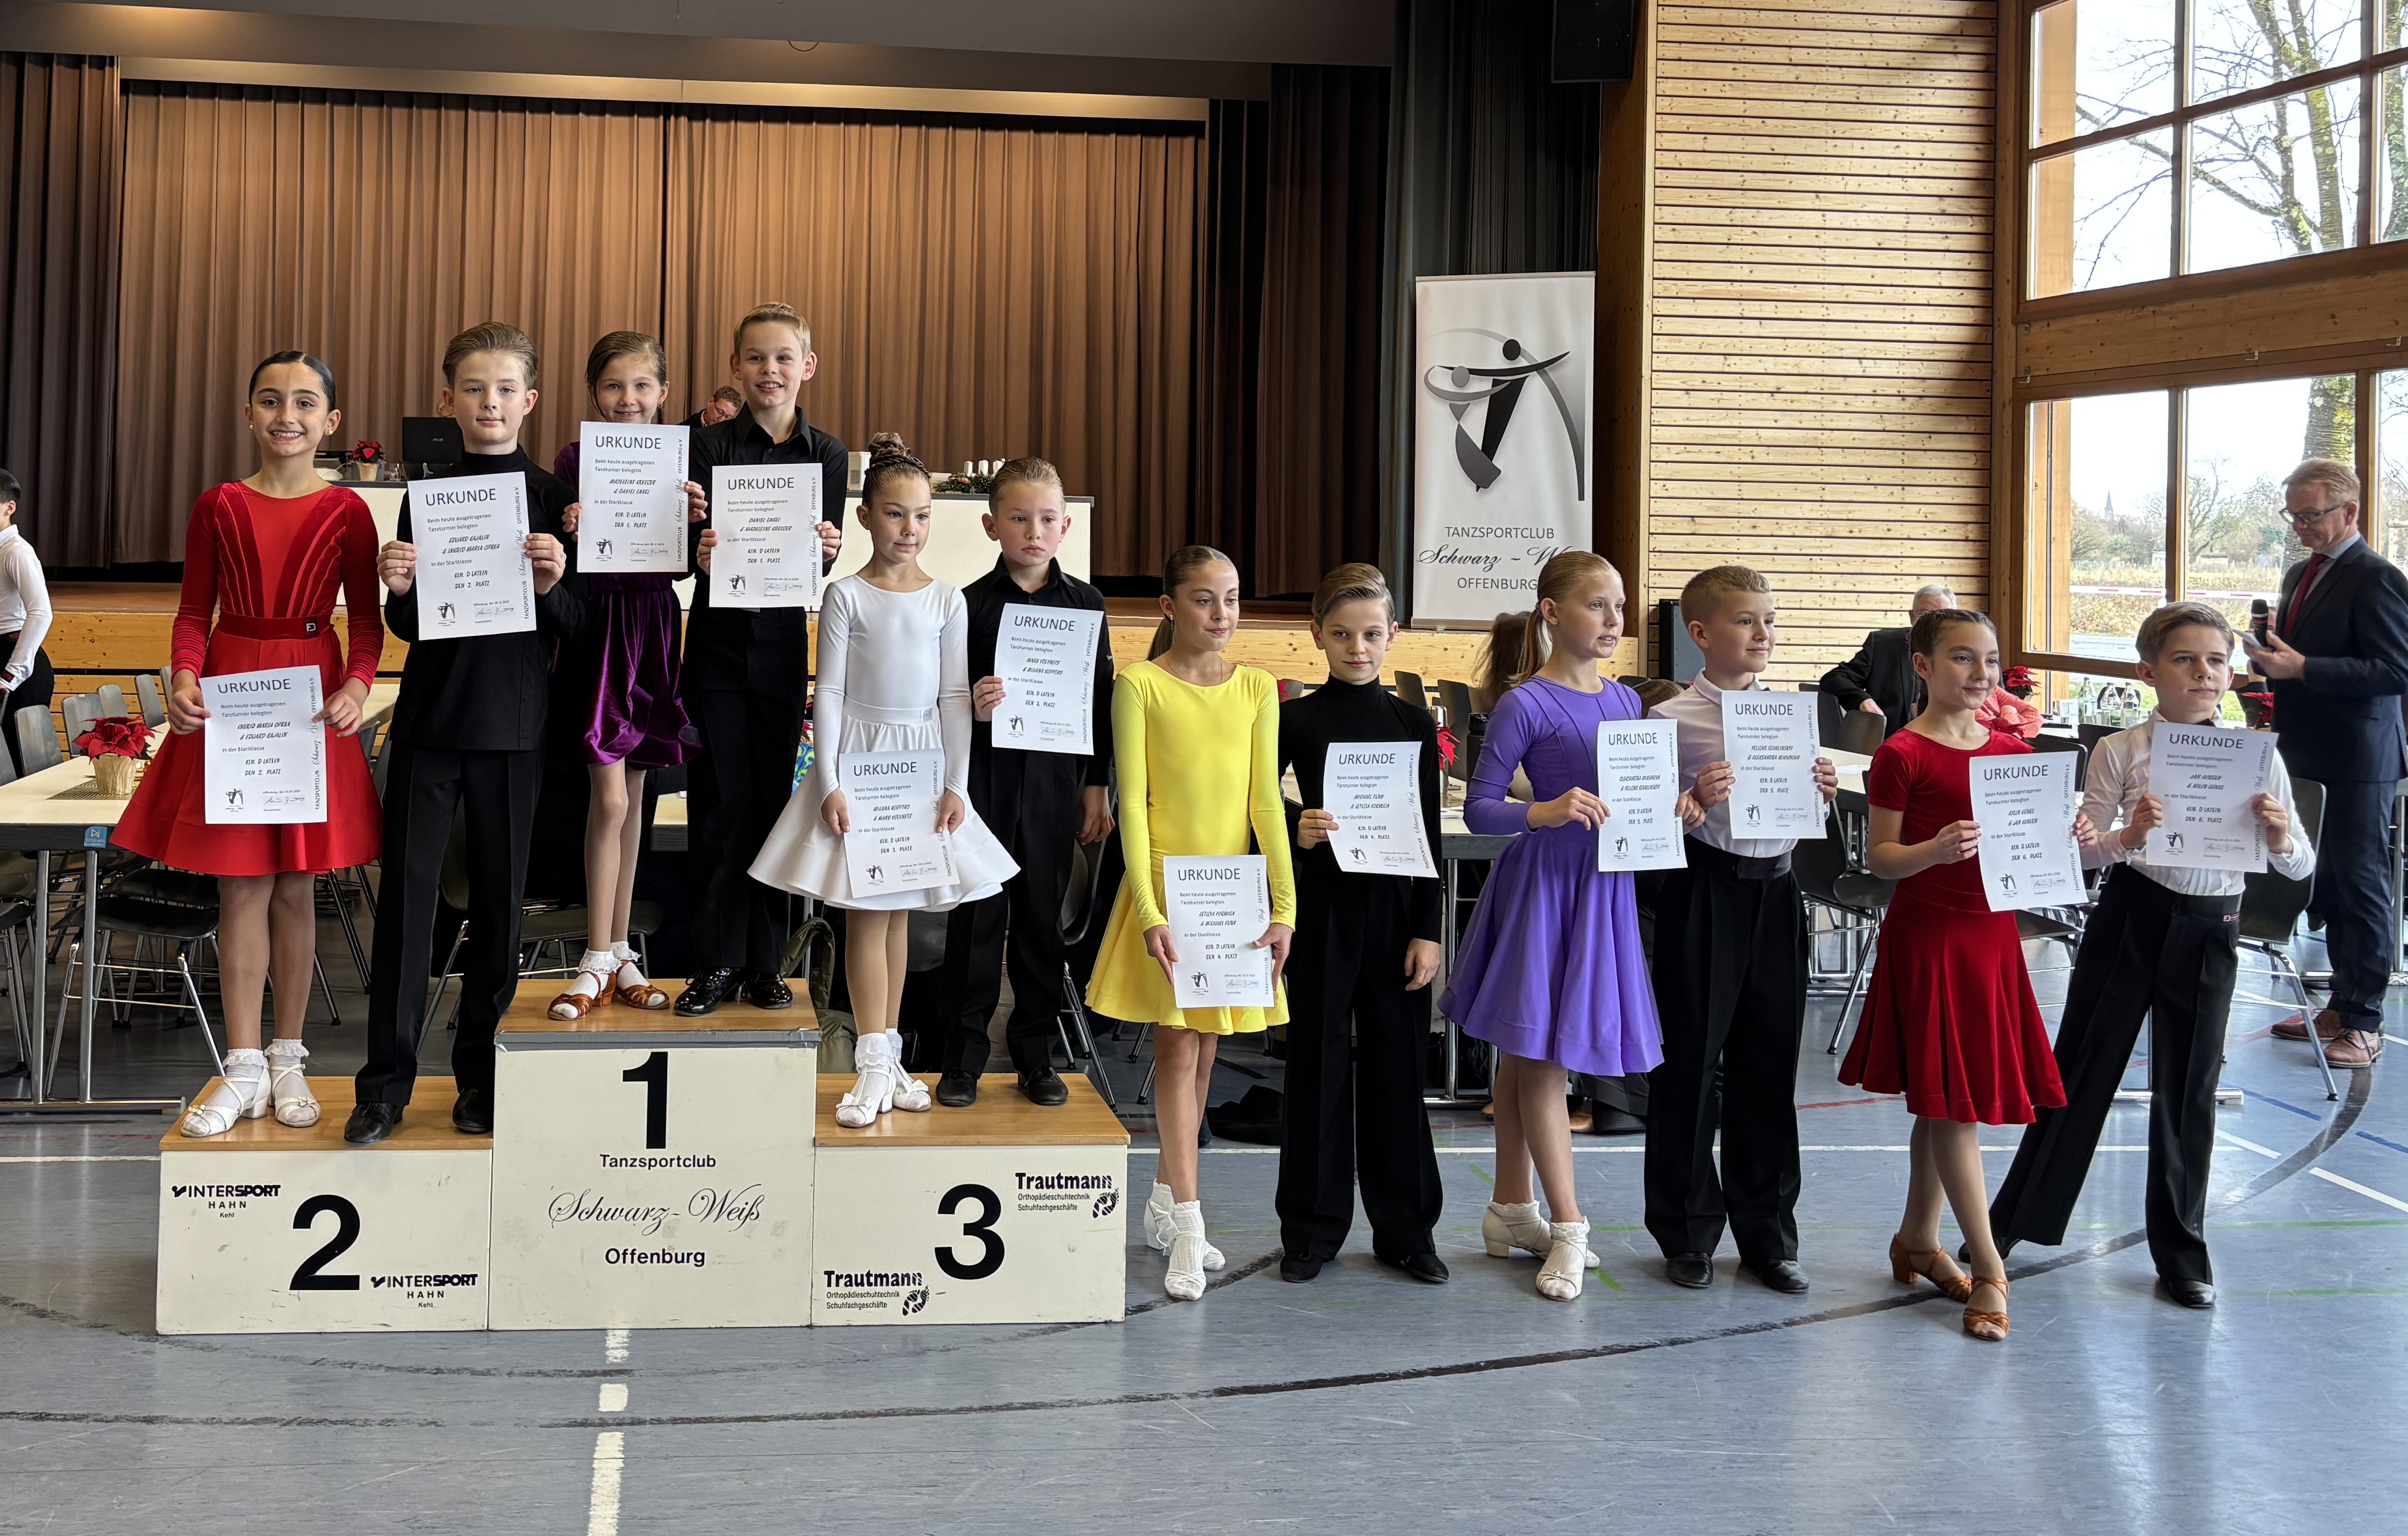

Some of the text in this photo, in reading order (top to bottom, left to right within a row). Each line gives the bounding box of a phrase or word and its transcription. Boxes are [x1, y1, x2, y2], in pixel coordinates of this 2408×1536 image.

[596, 436, 661, 449] URKUNDE
[728, 477, 794, 490] URKUNDE
[426, 488, 496, 505] URKUNDE
[1445, 527, 1554, 538] TANZSPORTCLUB
[1416, 544, 1502, 572] Schwarz
[1458, 578, 1538, 590] OFFENBURG
[1015, 616, 1075, 631] URKUNDE
[218, 679, 291, 693] URKUNDE
[1736, 704, 1793, 715] URKUNDE
[1609, 733, 1657, 745] URKUNDE
[2170, 734, 2244, 749] URKUNDE
[1339, 754, 1395, 764] URKUNDE
[854, 762, 917, 776] URKUNDE
[1985, 765, 2048, 781] URKUNDE
[1178, 869, 1240, 881] URKUNDE
[622, 1051, 668, 1149] 1
[600, 1154, 716, 1170] Tanzsportclub
[1015, 1172, 1112, 1189] Trautmann
[189, 1185, 281, 1198] INTERSPORT
[934, 1183, 1005, 1280] 3
[289, 1194, 360, 1291] 2
[605, 1248, 705, 1267] Offenburg
[387, 1274, 478, 1288] INTERSPORT
[824, 1270, 922, 1288] Trautmann
[407, 1290, 444, 1299] HAHN
